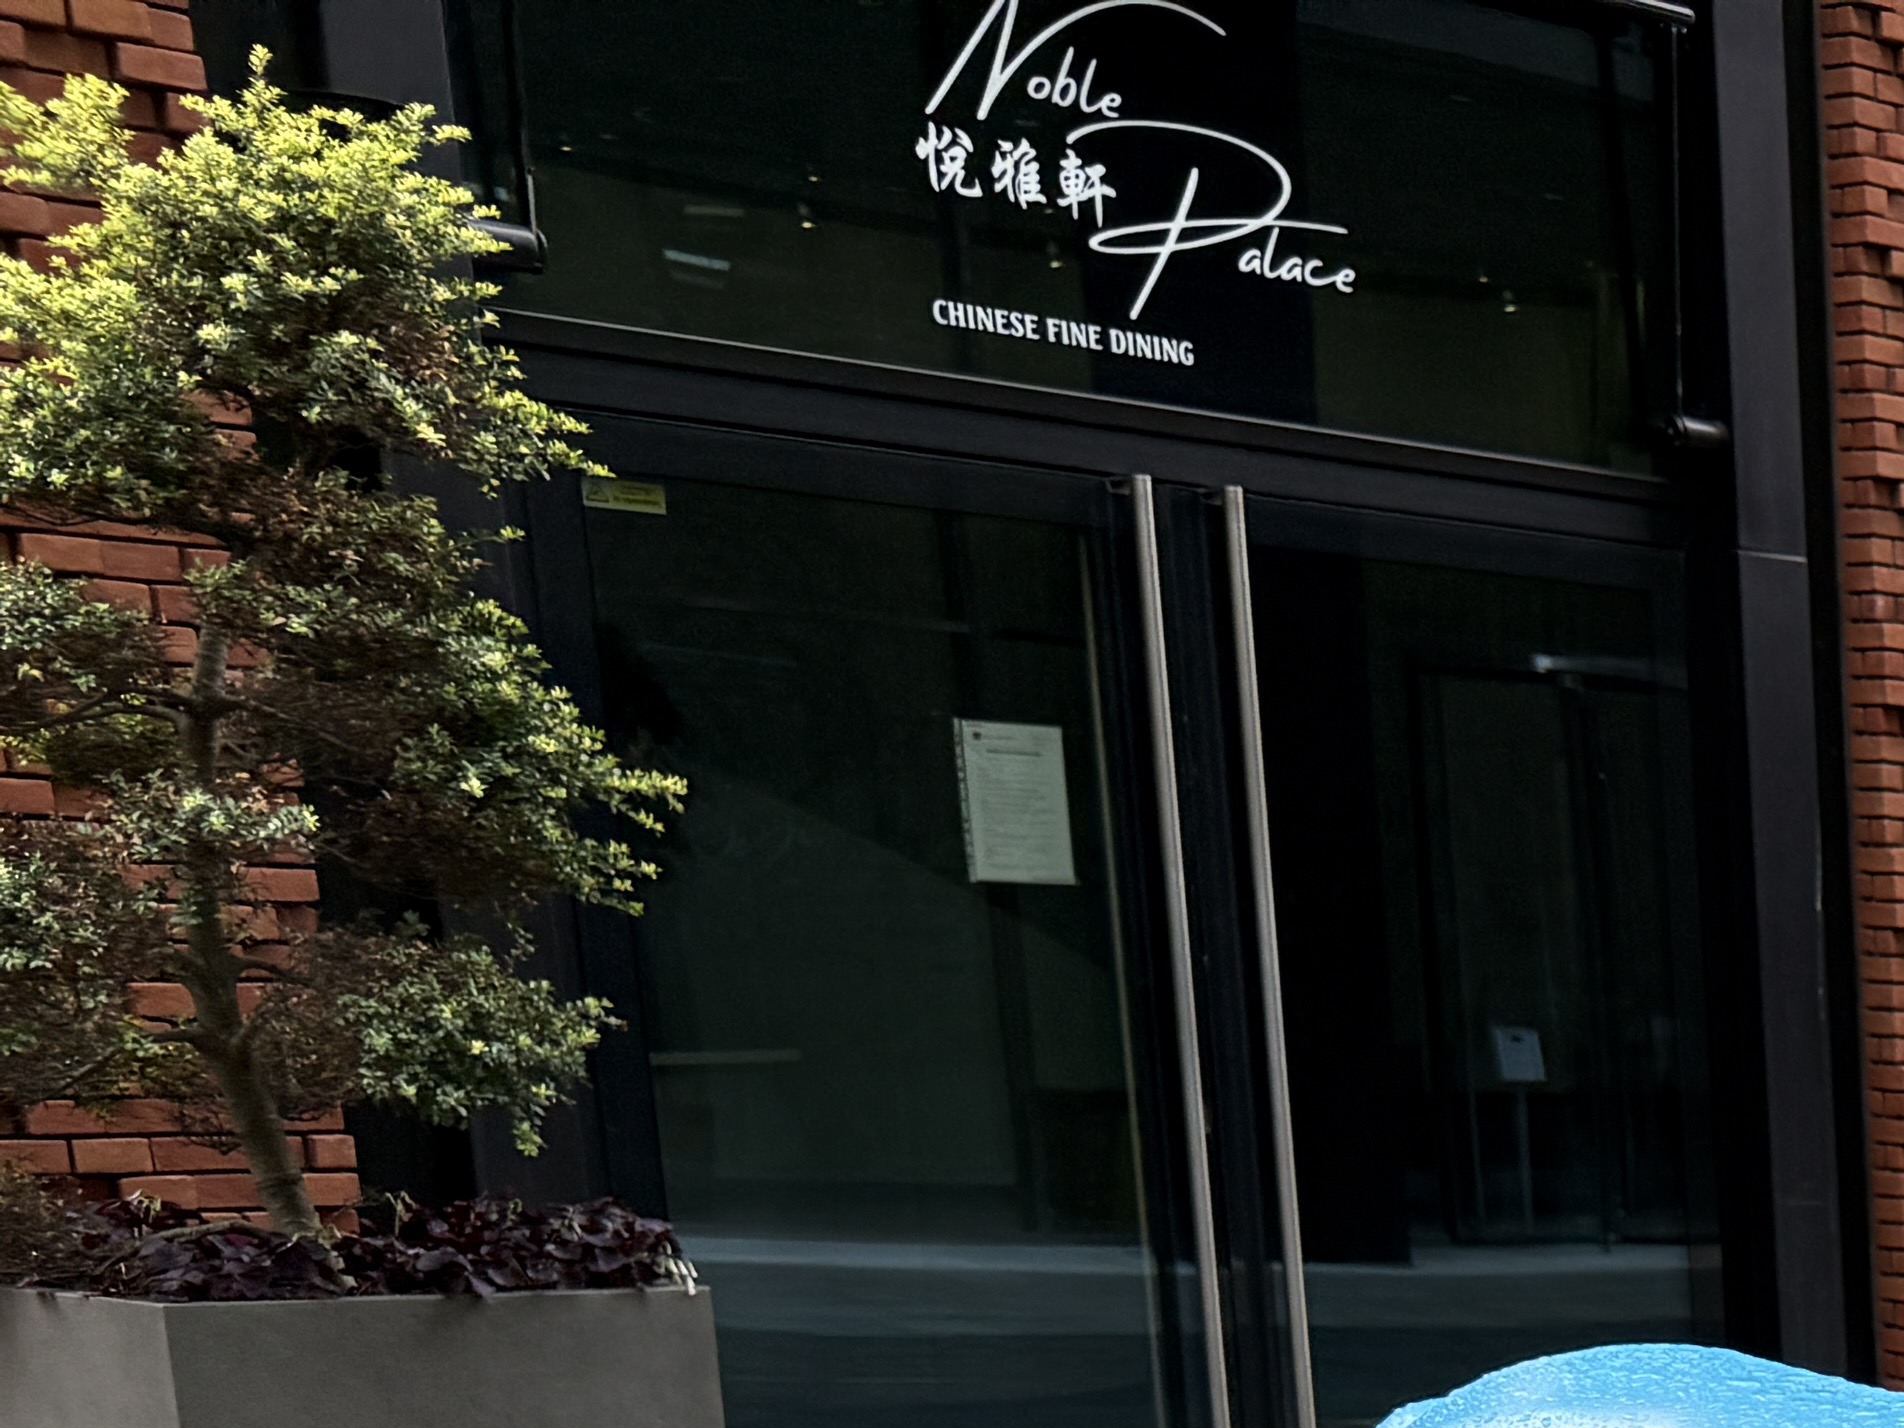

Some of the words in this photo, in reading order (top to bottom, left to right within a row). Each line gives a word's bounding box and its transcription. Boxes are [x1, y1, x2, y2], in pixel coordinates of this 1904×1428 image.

[925, 0, 1226, 118] Noble
[915, 122, 1116, 228] 悅雅軒
[1066, 119, 1356, 320] Palace
[933, 299, 1040, 340] CHINESE
[1046, 317, 1103, 351] FINE
[1109, 327, 1195, 366] DINING
